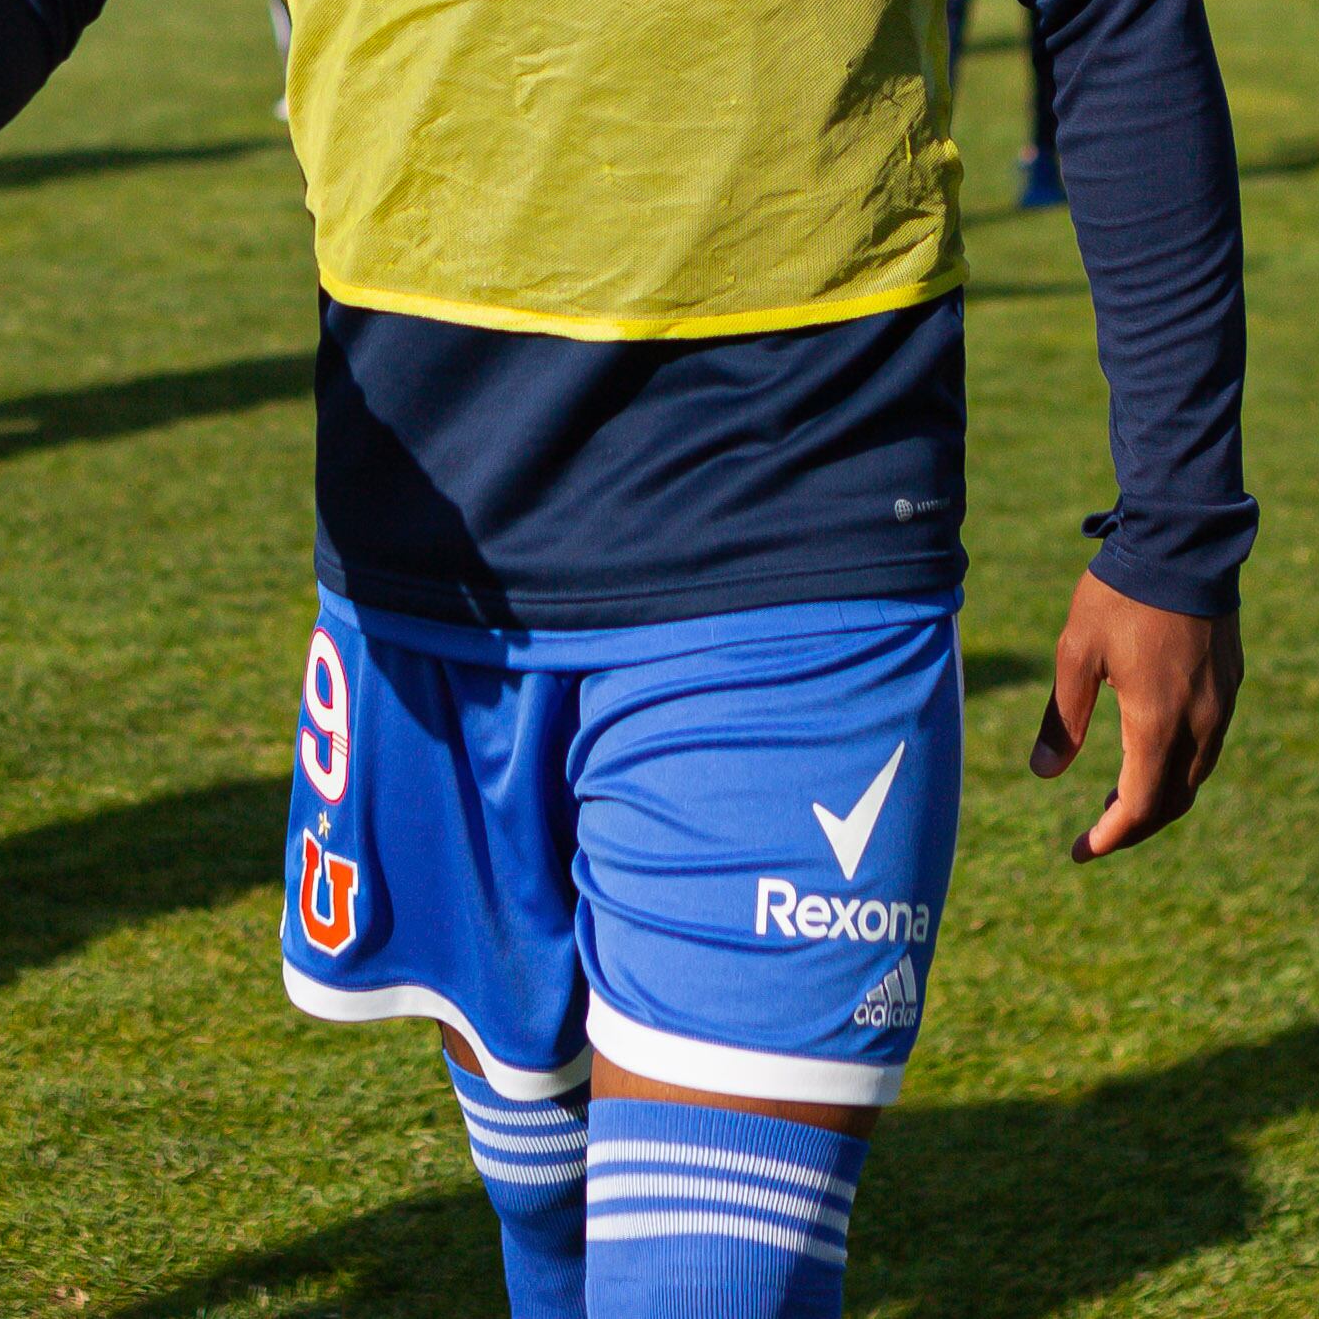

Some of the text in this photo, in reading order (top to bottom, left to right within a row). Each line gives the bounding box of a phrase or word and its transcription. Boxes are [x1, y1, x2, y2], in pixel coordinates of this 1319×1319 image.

[300, 626, 349, 806] 9
[299, 827, 358, 957] U
[755, 877, 930, 943] Rexona
[853, 1000, 918, 1028] adidas
